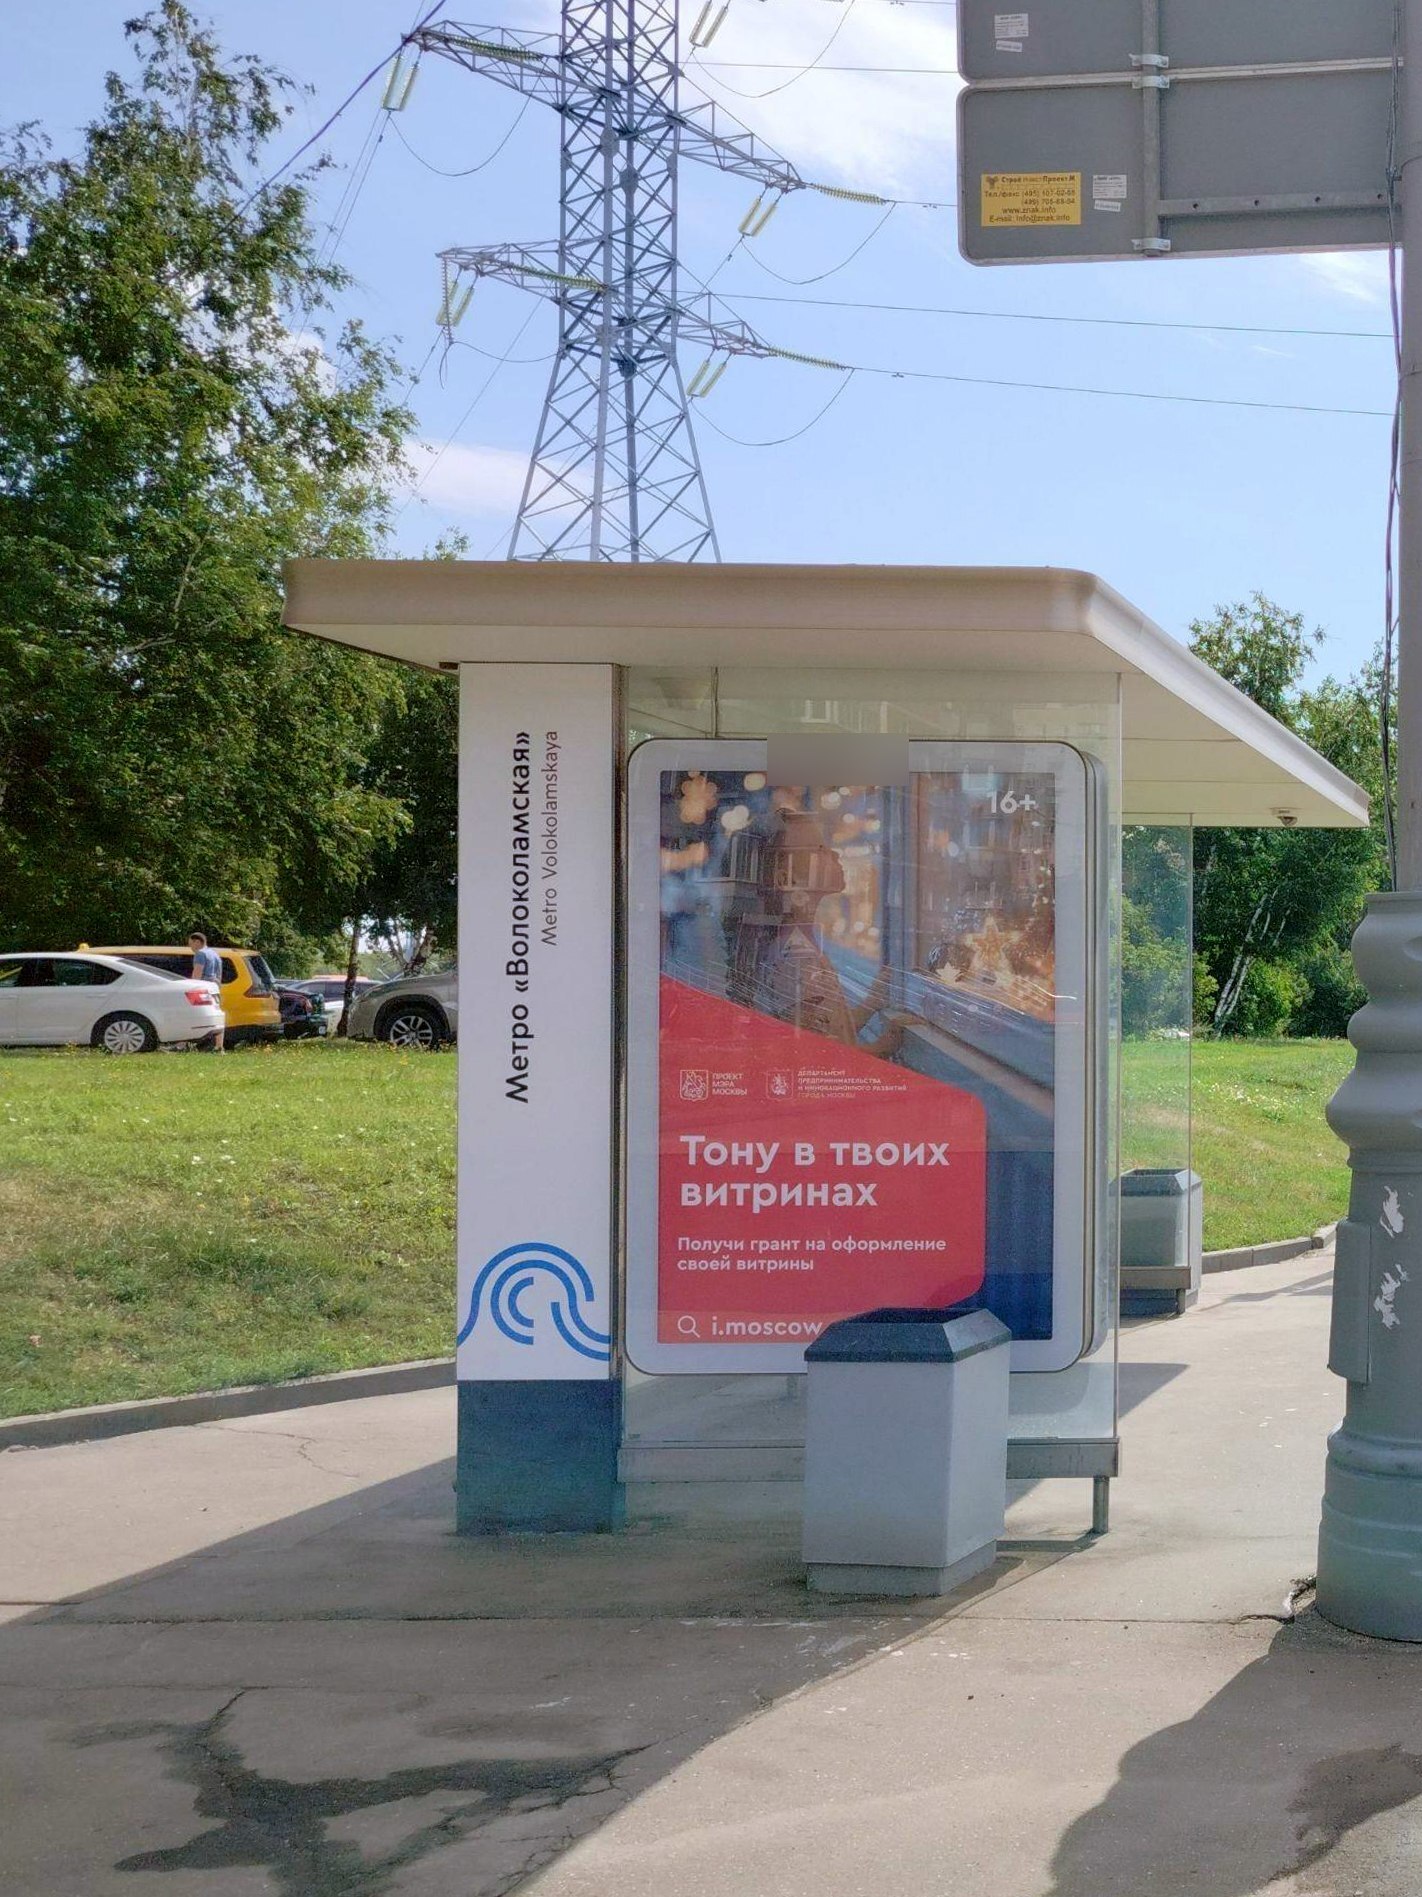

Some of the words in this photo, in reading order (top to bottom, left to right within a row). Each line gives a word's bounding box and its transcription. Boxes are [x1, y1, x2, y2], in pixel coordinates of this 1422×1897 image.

[541, 731, 561, 880] Volokolamskaya
[986, 790, 1036, 814] 16+
[505, 731, 530, 993] «Волоколамская»
[541, 887, 557, 946] Metro
[505, 1003, 534, 1104] Метро
[712, 1088, 748, 1096] МОСКВЫ
[680, 1135, 780, 1174] Тону
[794, 1142, 816, 1166] в
[830, 1142, 950, 1166] твоих
[681, 1182, 879, 1214] витринах
[677, 1237, 745, 1255] Получи
[750, 1240, 800, 1255] грант
[806, 1240, 826, 1251] на
[831, 1236, 947, 1254] оформление
[677, 1255, 731, 1271] своей
[736, 1258, 814, 1273] витрины
